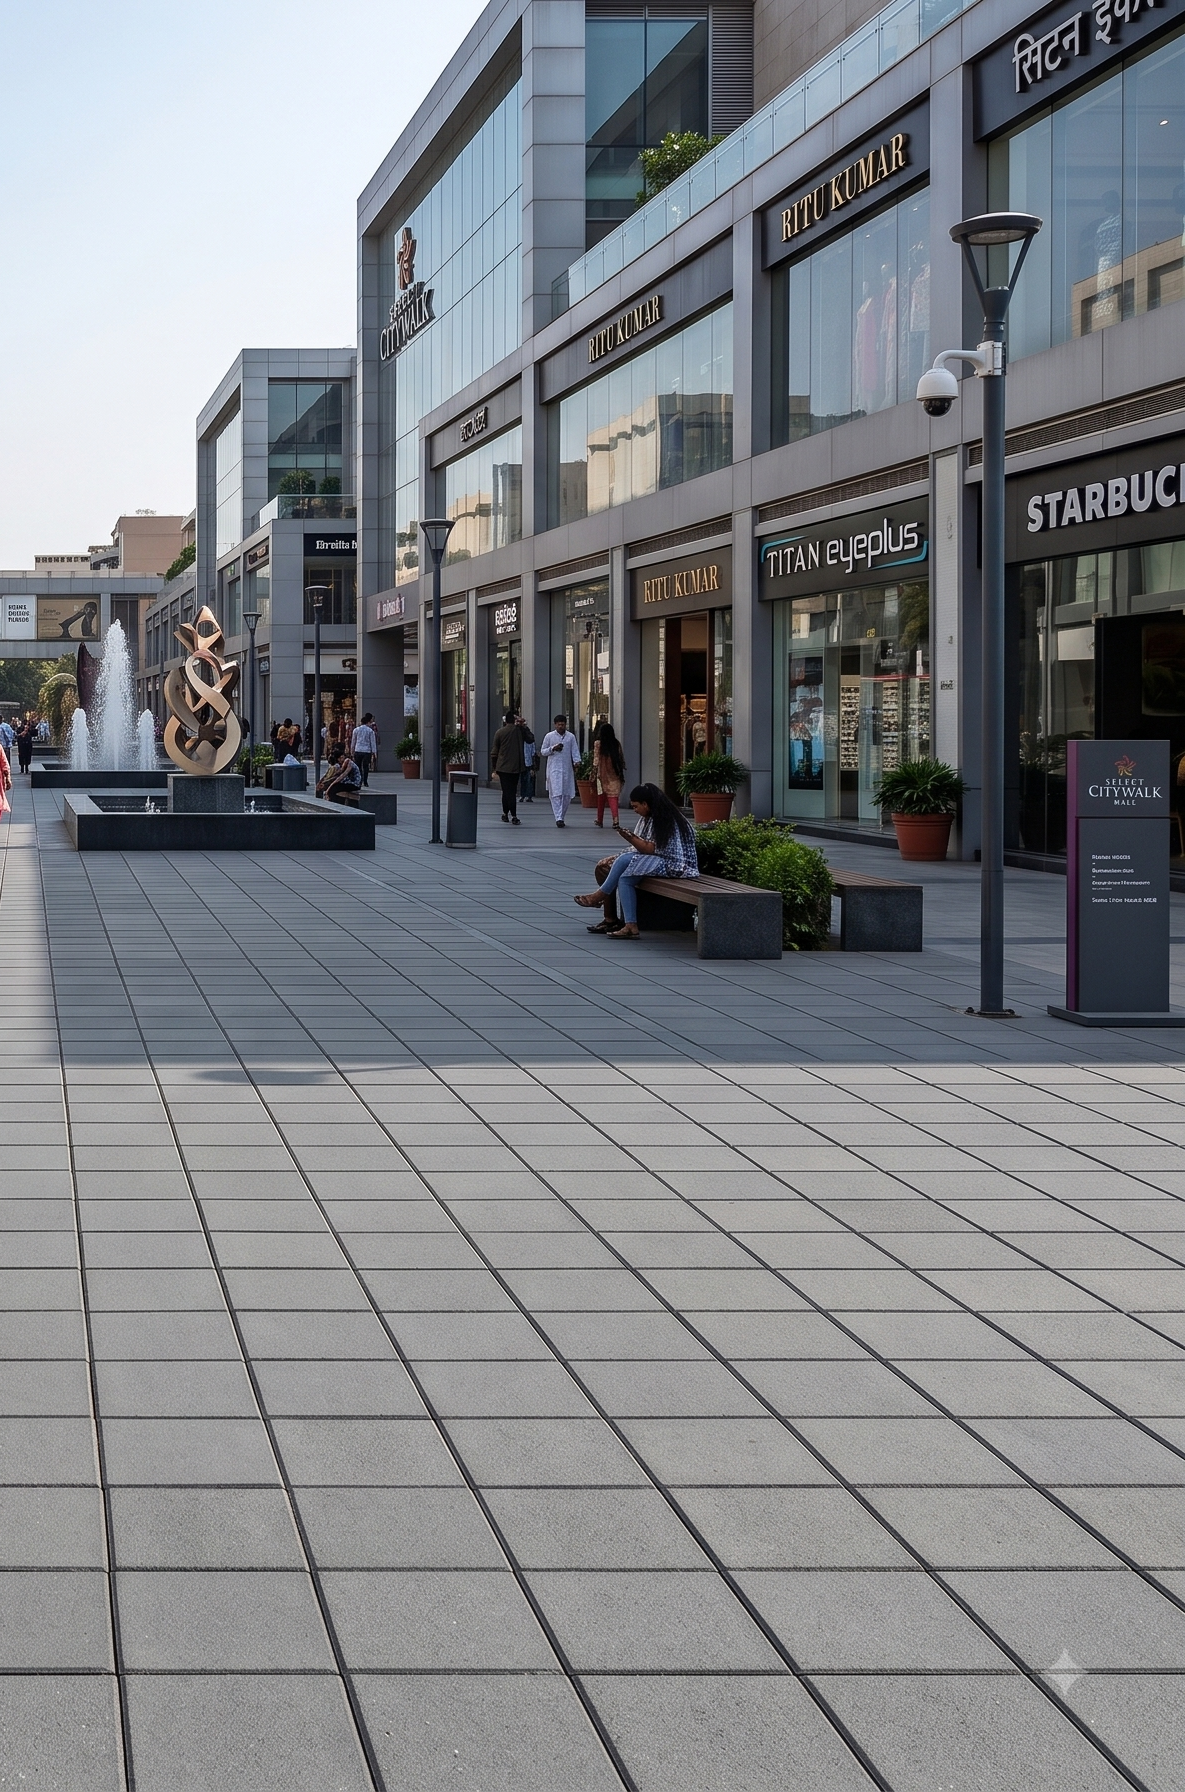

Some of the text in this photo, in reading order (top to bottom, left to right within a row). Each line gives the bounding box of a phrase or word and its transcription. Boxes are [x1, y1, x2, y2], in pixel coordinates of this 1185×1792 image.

[781, 133, 907, 242] RITU KUMAR
[380, 290, 434, 360] CITYWALK
[588, 295, 662, 363] RITU KUMAR
[1027, 462, 1185, 533] STARBUC
[767, 517, 918, 578] TITAN eyeplus
[644, 565, 719, 603] RITU KUMAR
[1088, 785, 1163, 798] CITYWALK
[1105, 778, 1144, 786] SELECT
